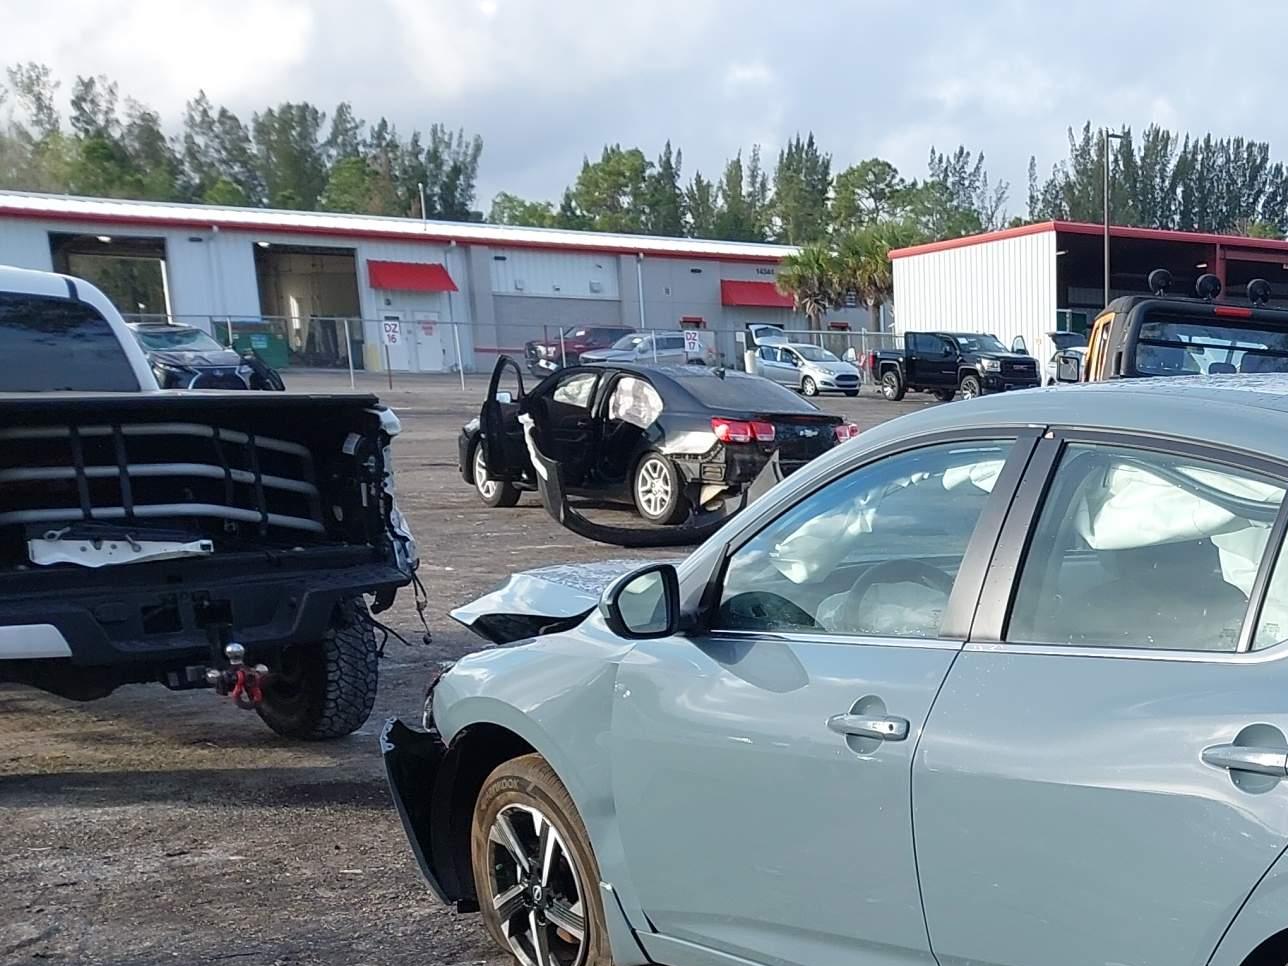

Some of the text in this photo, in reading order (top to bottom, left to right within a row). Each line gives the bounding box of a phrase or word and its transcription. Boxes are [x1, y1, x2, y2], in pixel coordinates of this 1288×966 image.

[383, 322, 398, 333] DZ
[387, 334, 397, 344] 16
[685, 331, 697, 341] DZ
[688, 341, 696, 350] 17
